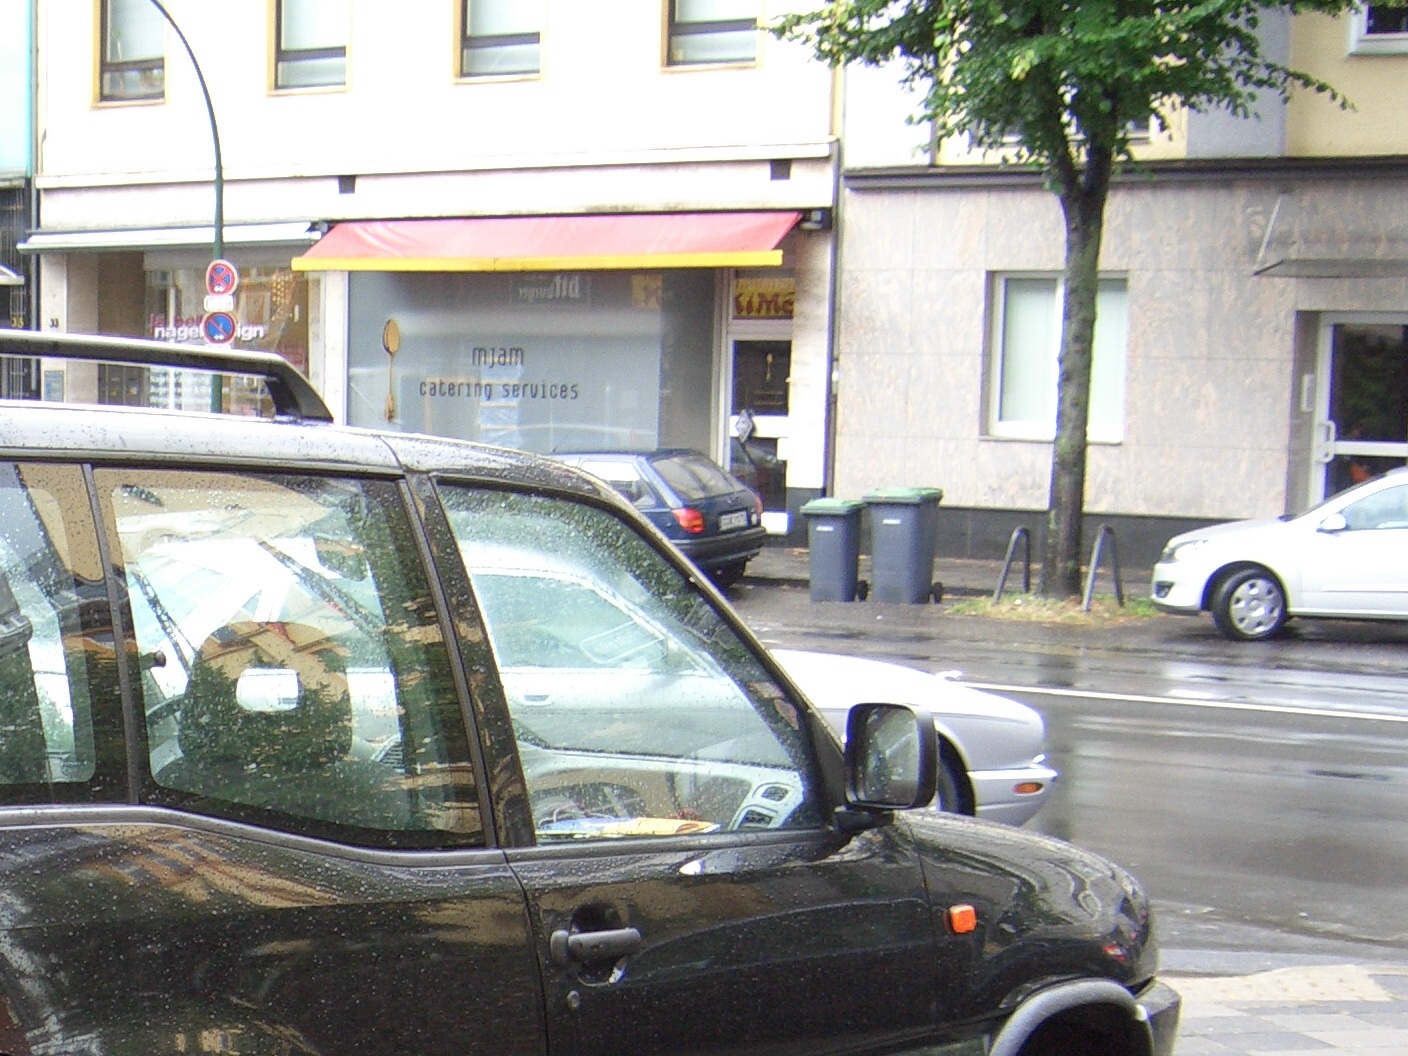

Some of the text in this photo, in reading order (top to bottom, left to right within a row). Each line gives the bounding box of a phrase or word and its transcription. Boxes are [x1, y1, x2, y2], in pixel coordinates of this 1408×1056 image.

[472, 346, 525, 368] mjam
[420, 379, 579, 401] catering services
